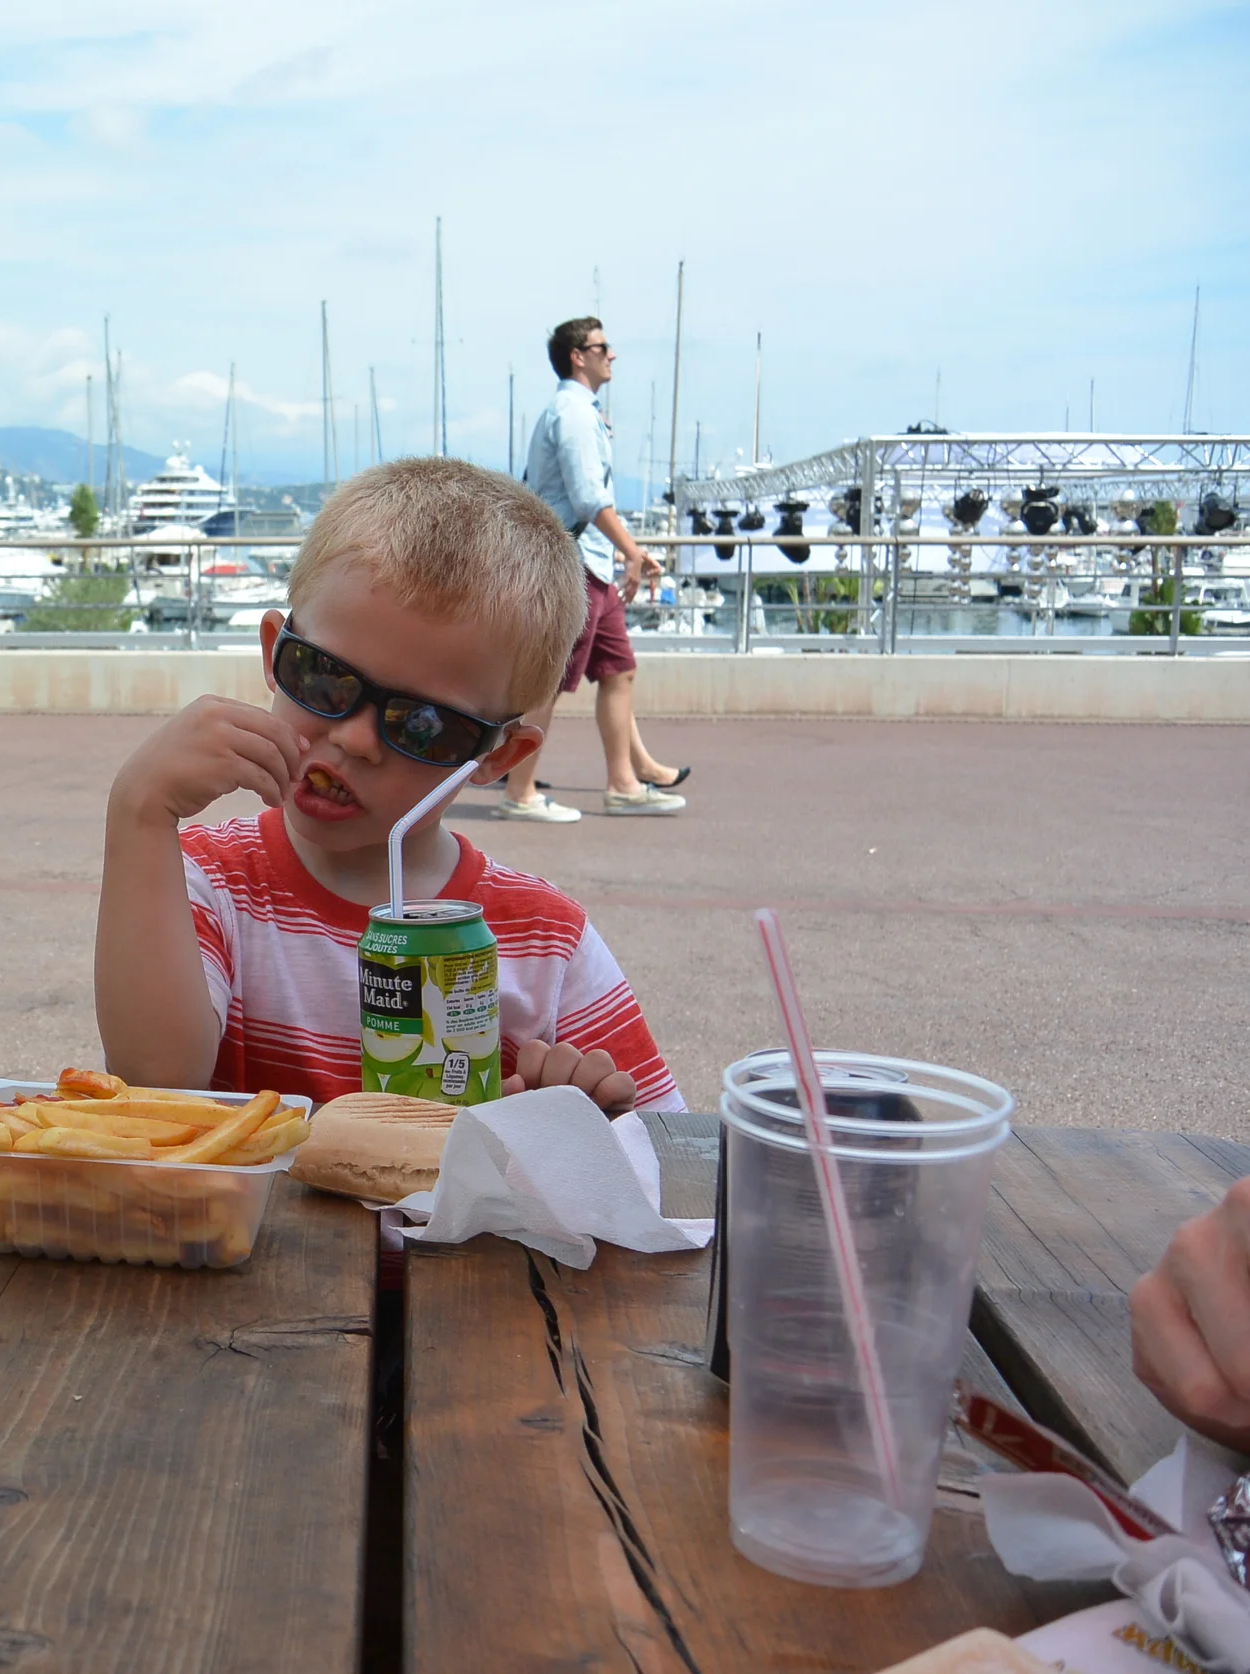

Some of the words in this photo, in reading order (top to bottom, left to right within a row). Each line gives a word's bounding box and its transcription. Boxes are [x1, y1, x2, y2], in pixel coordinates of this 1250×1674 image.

[379, 932, 407, 945] SUCRES
[360, 965, 413, 991] Minute
[364, 986, 403, 1010] Maid
[366, 1016, 400, 1031] POMME
[449, 1058, 466, 1069] 1/5
